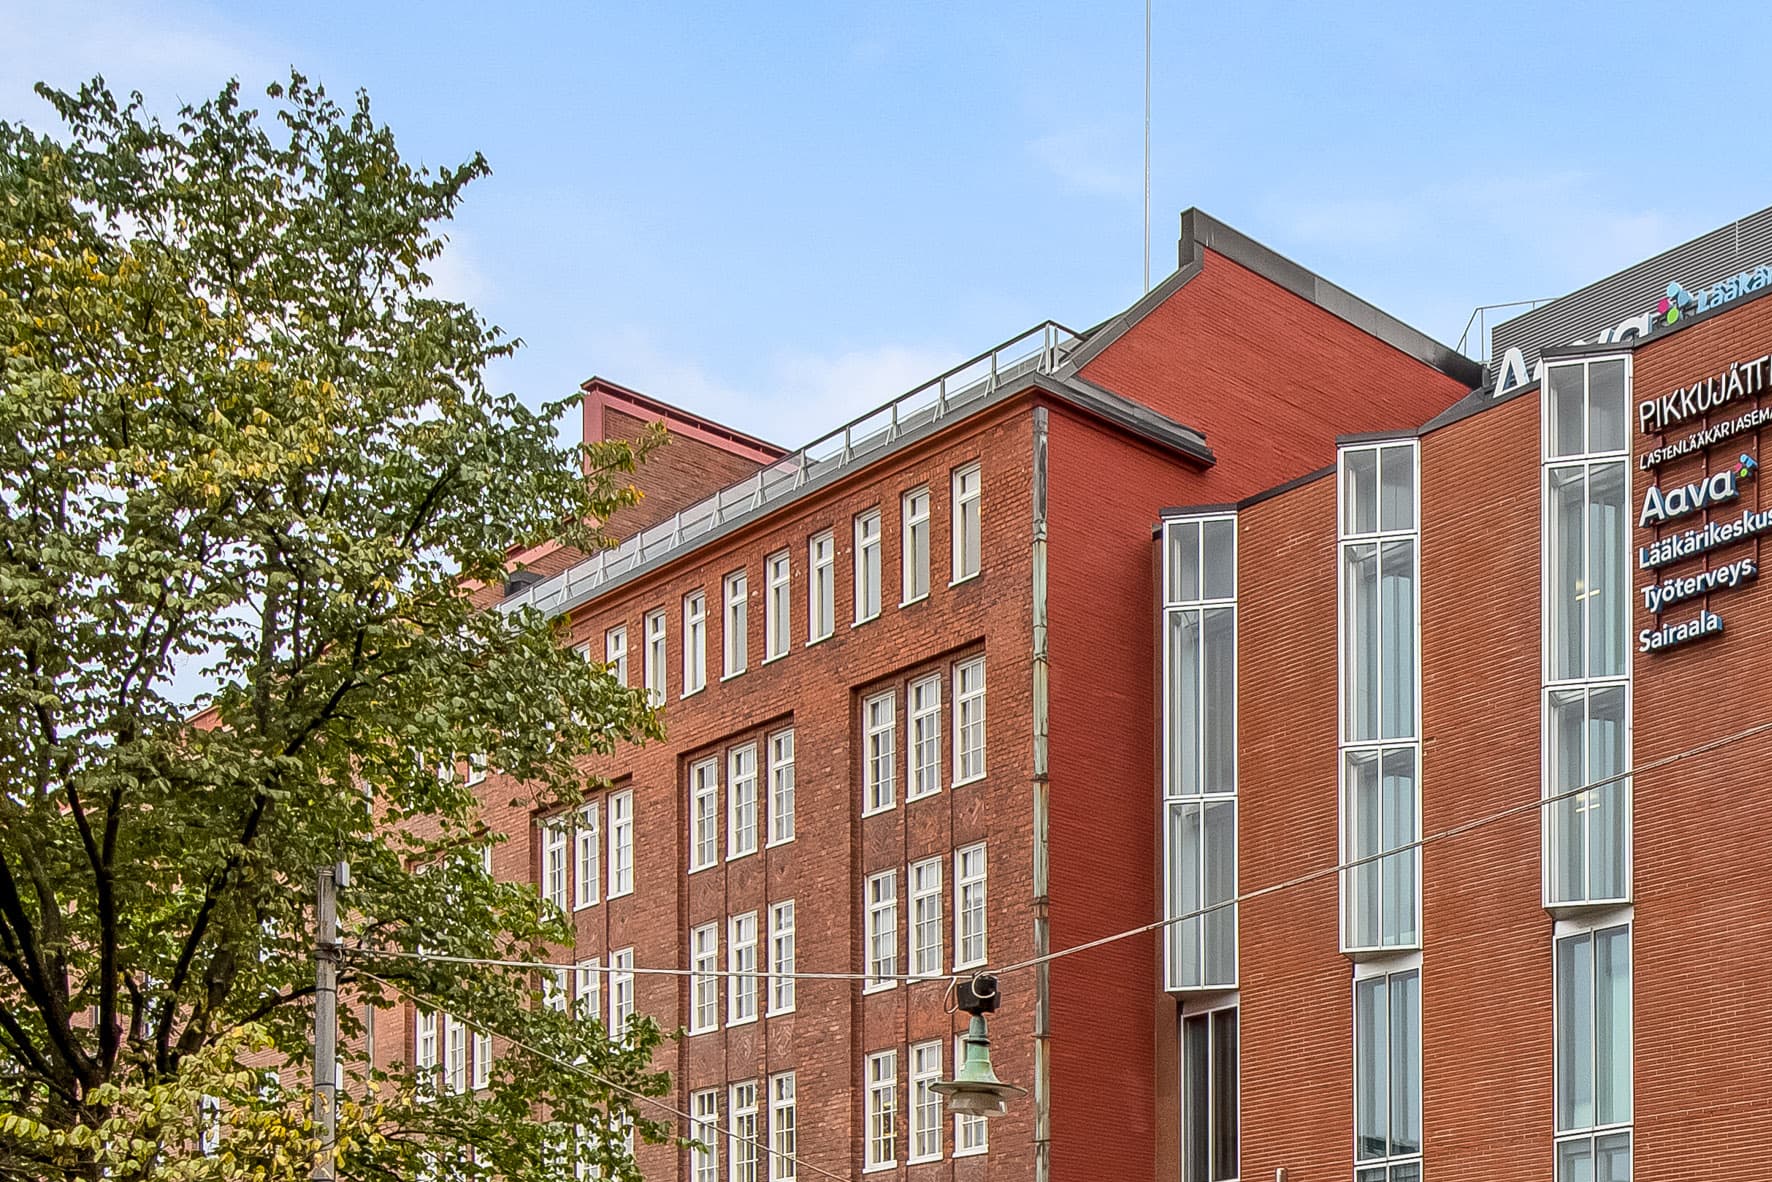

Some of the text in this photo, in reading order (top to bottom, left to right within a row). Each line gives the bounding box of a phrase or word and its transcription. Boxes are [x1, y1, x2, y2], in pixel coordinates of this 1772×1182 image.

[1638, 469, 1737, 528] Aava
[1640, 557, 1756, 614] Työterveys
[1639, 609, 1721, 653] Sairaala
